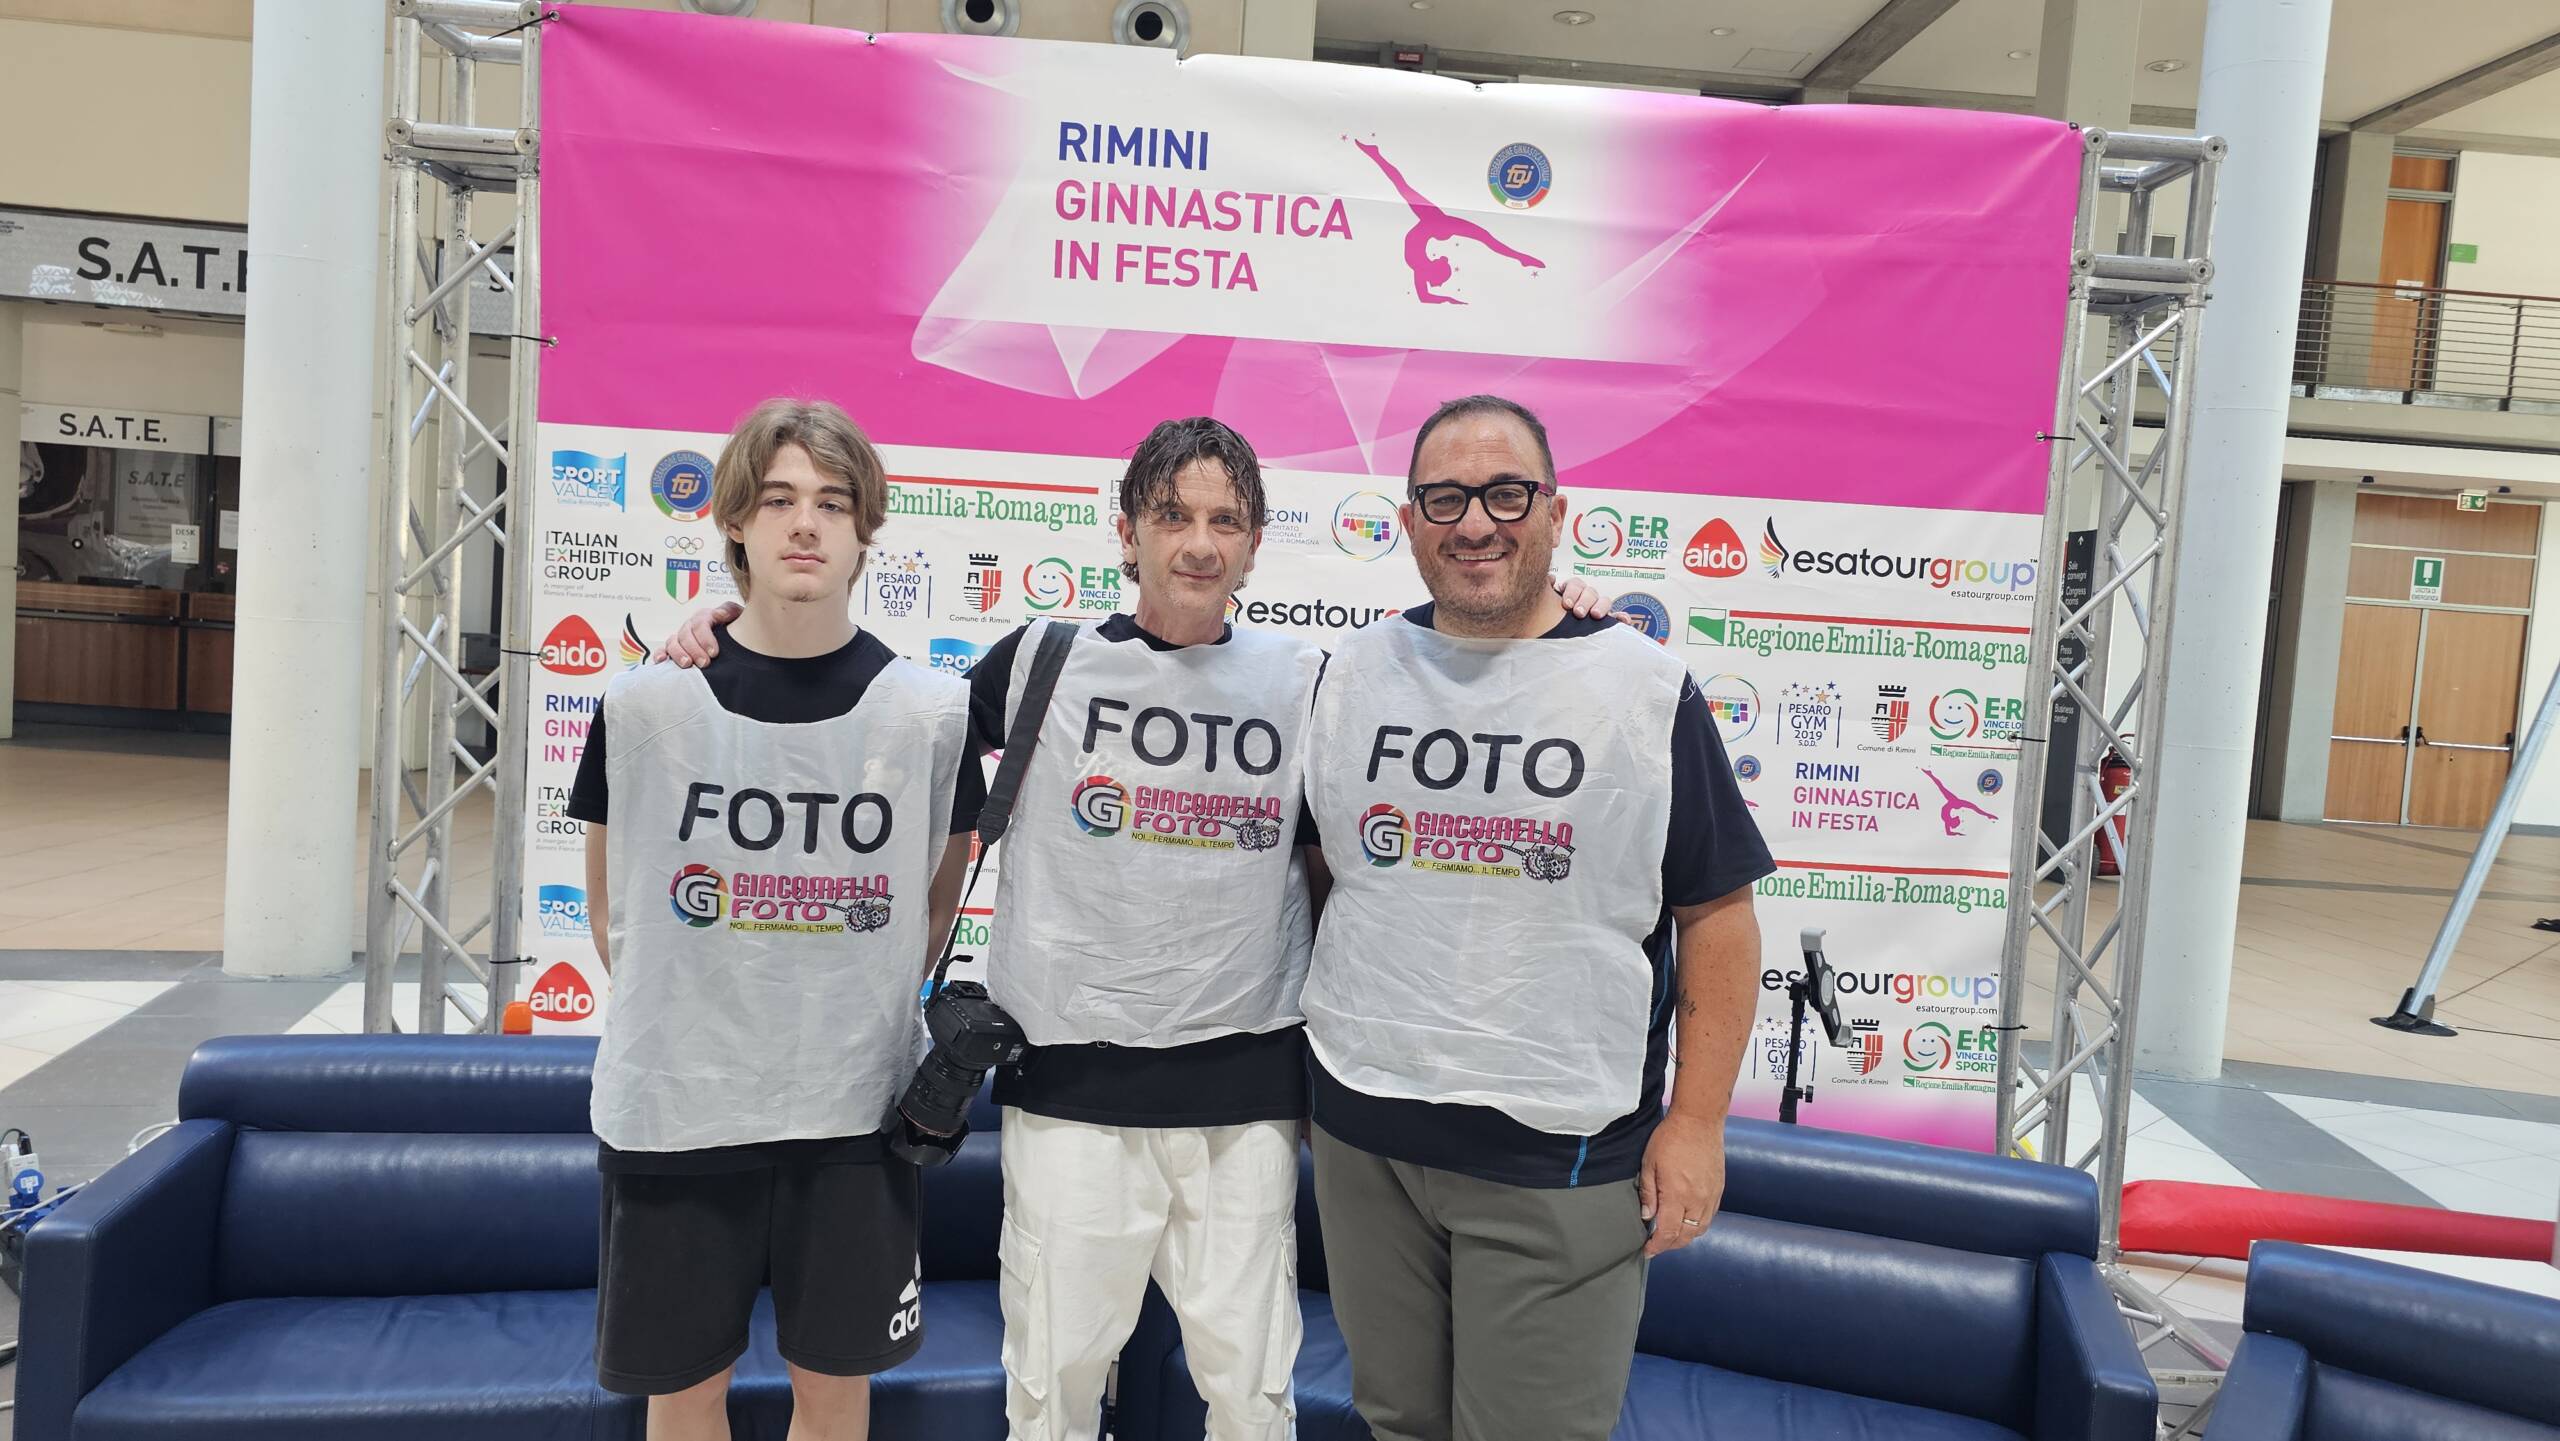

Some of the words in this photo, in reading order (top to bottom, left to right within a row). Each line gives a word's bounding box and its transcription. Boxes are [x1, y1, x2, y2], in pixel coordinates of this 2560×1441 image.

[1058, 122, 1208, 170] RIMINI
[1055, 180, 1353, 240] GINNASTICA
[1053, 240, 1099, 281] IN
[1116, 245, 1258, 293] FESTA
[59, 413, 167, 443] S.A.T.E.
[552, 466, 621, 484] SPORT
[552, 482, 620, 499] VALLEY
[175, 528, 196, 536] DESK
[546, 531, 618, 548] ITALIAN
[182, 541, 189, 550] 2
[1627, 539, 1654, 548] VINCE
[1655, 540, 1668, 549] LO
[545, 547, 653, 567] EXHIBITION
[1626, 548, 1667, 560] SPORT
[1685, 544, 1745, 570] aido
[669, 560, 698, 569] ITALIA
[707, 561, 730, 574] CO
[544, 565, 611, 581] GROUP
[876, 573, 921, 585] PESARO
[879, 585, 917, 600] GYM
[1080, 590, 1107, 599] VINCE
[1109, 591, 1120, 600] LO
[1951, 589, 2034, 602] esatourgroup.com
[883, 600, 912, 611] 2019
[1079, 599, 1121, 611] SPORT
[949, 615, 978, 623] Comune
[981, 615, 987, 623] di
[989, 616, 1010, 624] Rimini
[542, 639, 606, 668] aido
[1789, 703, 1831, 715] PESARO
[1791, 715, 1827, 730] GYM
[1983, 720, 2009, 729] VINCE
[2011, 721, 2022, 729] LO
[1083, 697, 1282, 776] FOTO
[1794, 730, 1823, 740] 2019
[1982, 729, 2020, 740] SPO
[544, 745, 565, 762] IN
[1857, 744, 1885, 753] Comune
[1895, 746, 1916, 754] Rimini
[1367, 725, 1585, 798] FOTO
[1795, 762, 1859, 782] RIMINI
[1135, 785, 1281, 819] GIACOMELLO
[1793, 786, 1920, 810] GINNASTICA
[1076, 783, 1124, 830] G
[678, 782, 893, 854] FOTO
[1133, 810, 1221, 837] FOTO
[1792, 811, 1812, 828] IN
[1818, 813, 1879, 832] FESTA
[1363, 813, 1404, 859] G
[1415, 811, 1573, 849] GIACOMELLO
[1209, 841, 1235, 849] TEMPO
[1413, 837, 1504, 863] FOTO
[1491, 867, 1521, 877] TEMPO
[732, 872, 889, 901] GIACOMELLO
[674, 873, 720, 921] G
[731, 898, 827, 921] FOTO
[806, 924, 815, 932] IL
[816, 924, 844, 933] TEMPO
[1761, 968, 1998, 1005] esourgroup
[529, 986, 593, 1014] aido
[1916, 1004, 1998, 1015] esatourgroup.com
[1765, 1037, 1807, 1050] PESAO
[1956, 1051, 1984, 1061] VINCE
[1985, 1053, 1997, 1061] LO
[1955, 1062, 1997, 1073] SPORT
[1831, 1077, 1859, 1085] Comune
[1868, 1078, 1889, 1086] Rimini
